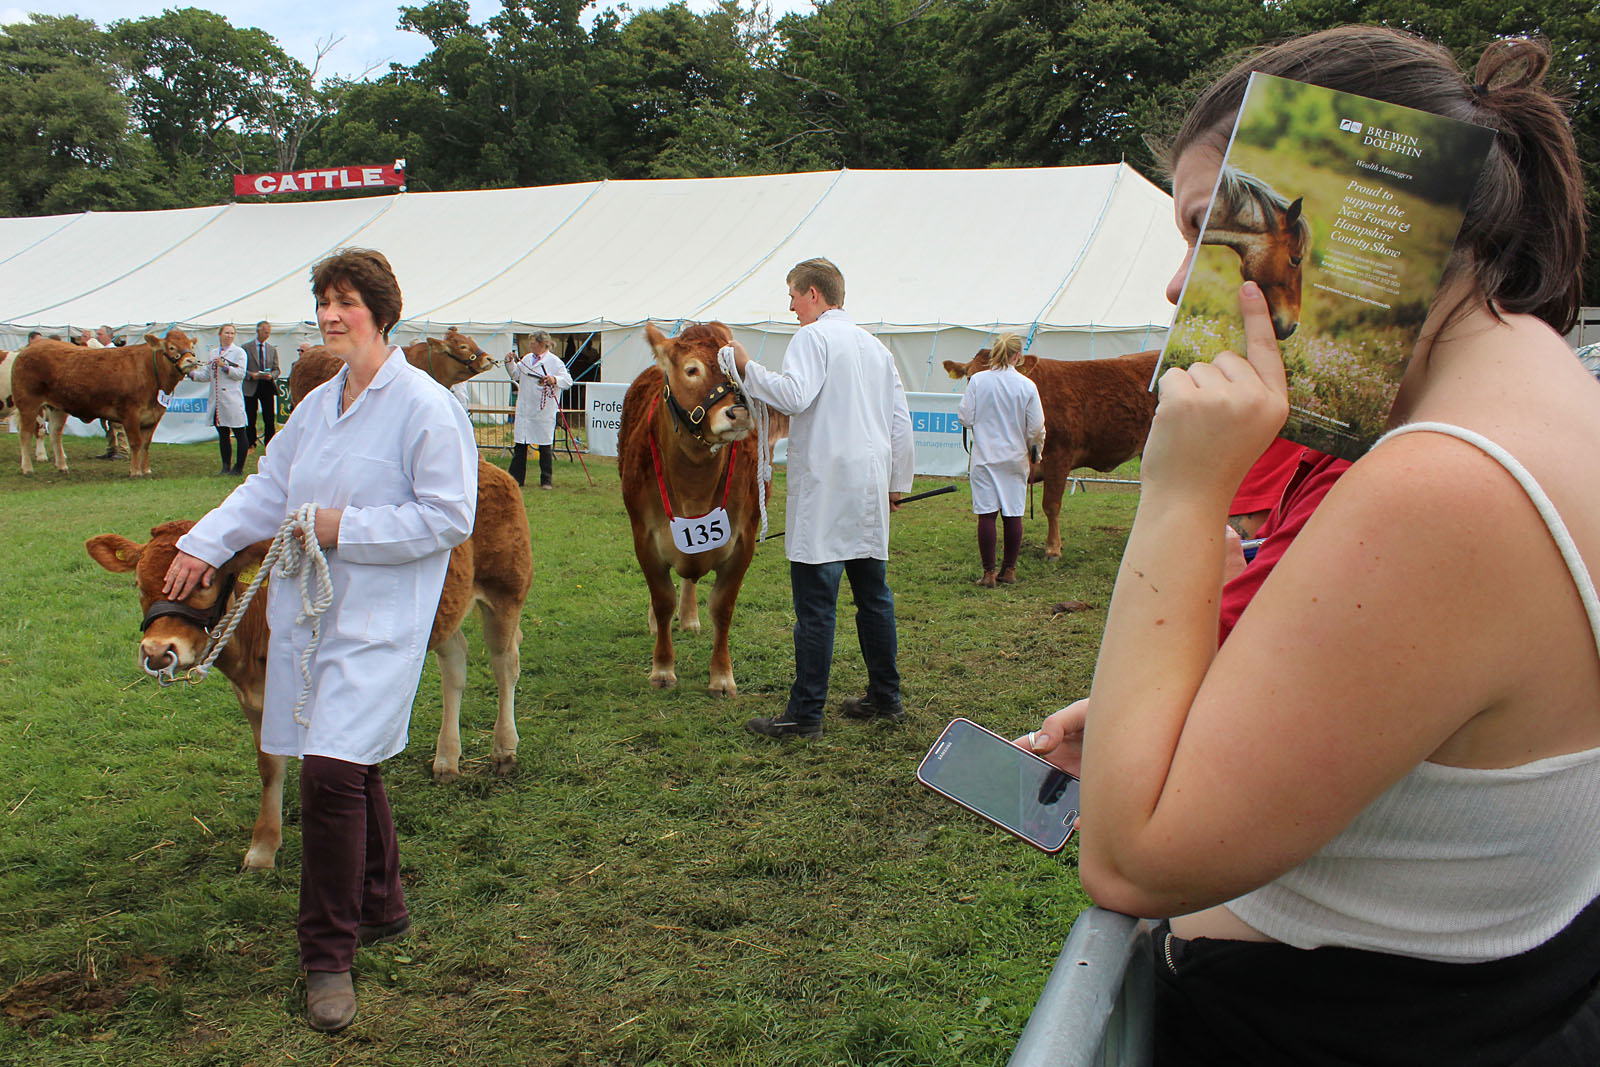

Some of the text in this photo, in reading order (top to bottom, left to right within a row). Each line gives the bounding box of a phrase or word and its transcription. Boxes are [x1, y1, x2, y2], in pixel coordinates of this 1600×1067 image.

[1363, 136, 1423, 158] DOLPHIN
[1367, 126, 1419, 146] BREWIN
[254, 168, 385, 193] CATTLE
[1355, 159, 1414, 180] Wealth Managers
[1347, 180, 1394, 201] Proud to
[1344, 196, 1405, 218] support the
[1333, 217, 1394, 242] Hampshire
[1338, 205, 1411, 233] New Forest &
[1330, 230, 1370, 251] County
[1370, 241, 1401, 258] Show
[593, 400, 622, 412] Profe
[592, 417, 620, 429] inves
[916, 439, 962, 449] management
[681, 520, 724, 547] 135
